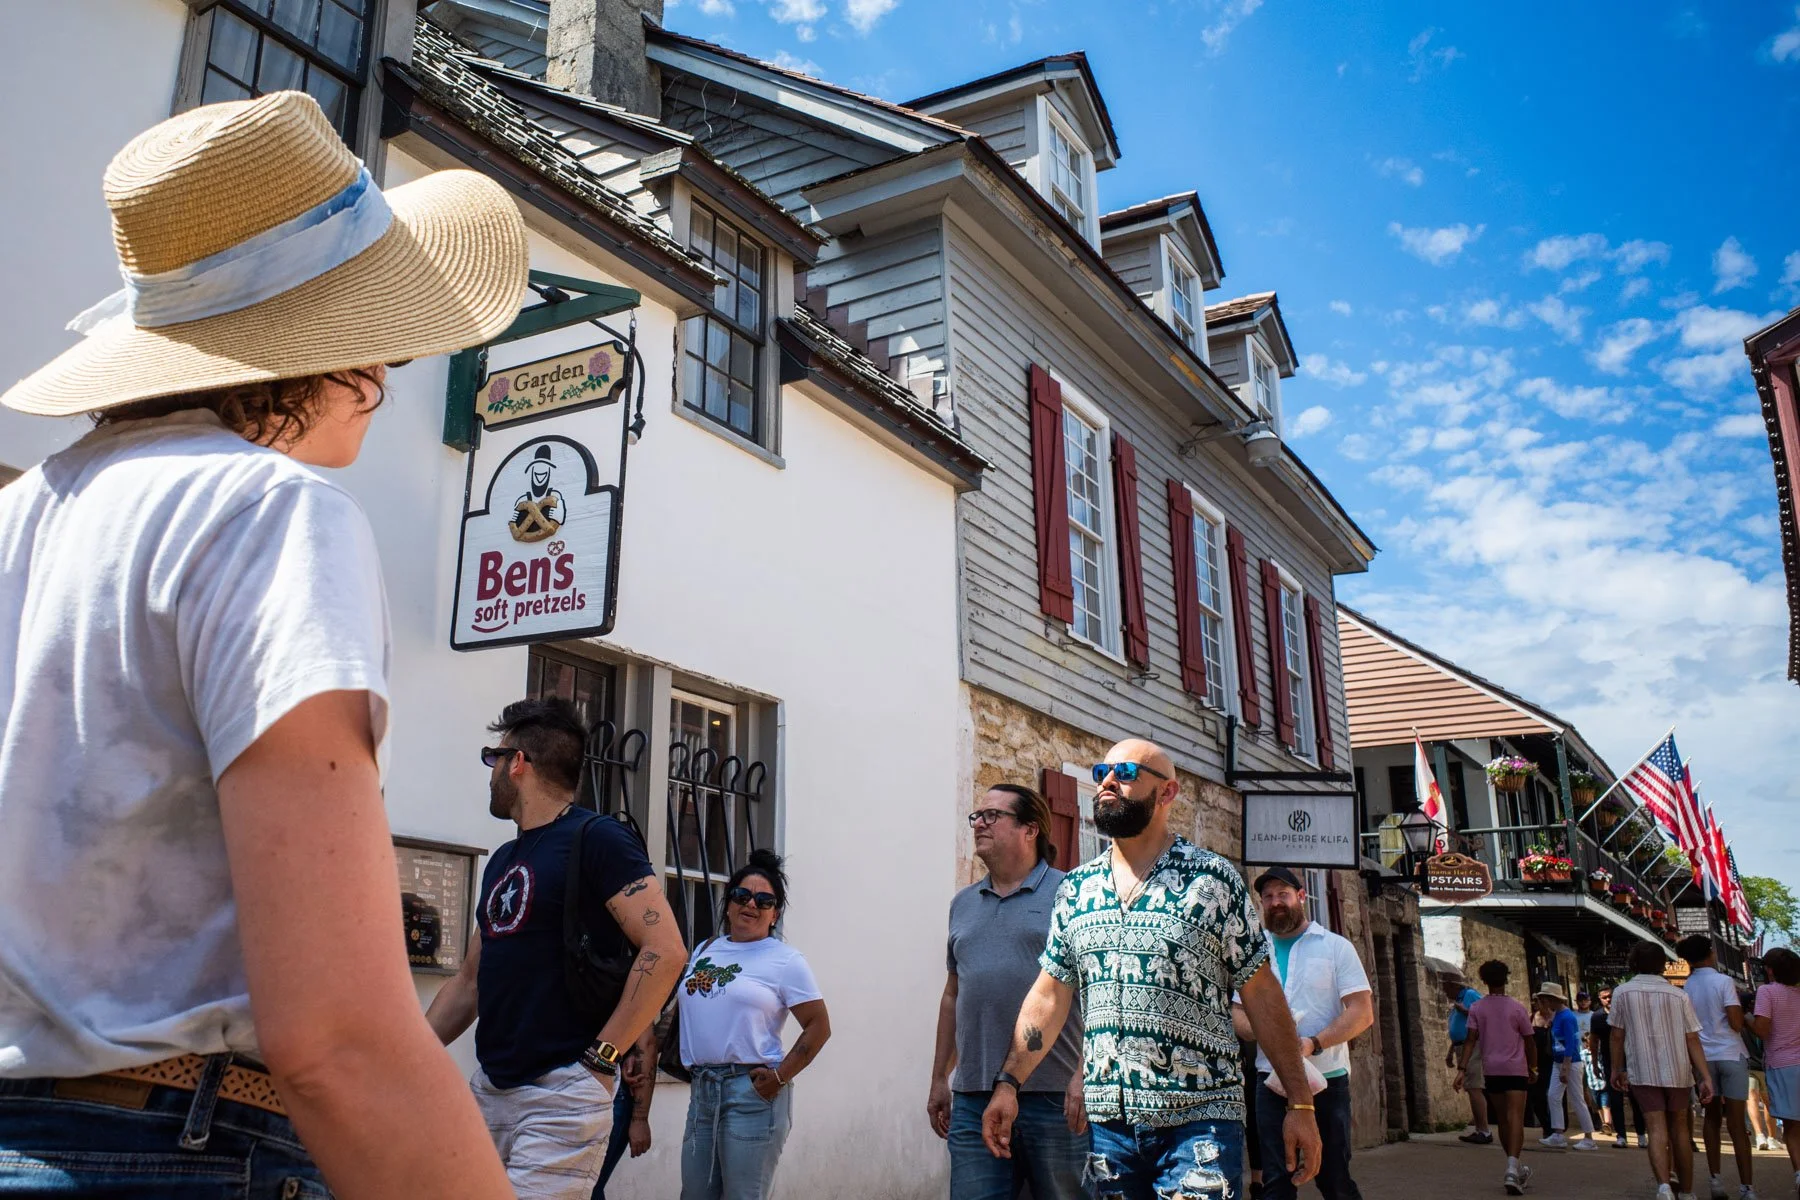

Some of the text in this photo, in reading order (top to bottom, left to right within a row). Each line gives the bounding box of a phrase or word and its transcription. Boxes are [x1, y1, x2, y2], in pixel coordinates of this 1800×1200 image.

[513, 364, 585, 392] Garden
[537, 384, 557, 406] 54
[474, 587, 586, 625] soft pretzels
[1251, 833, 1350, 844] JEAN-PIERRE KLIFA
